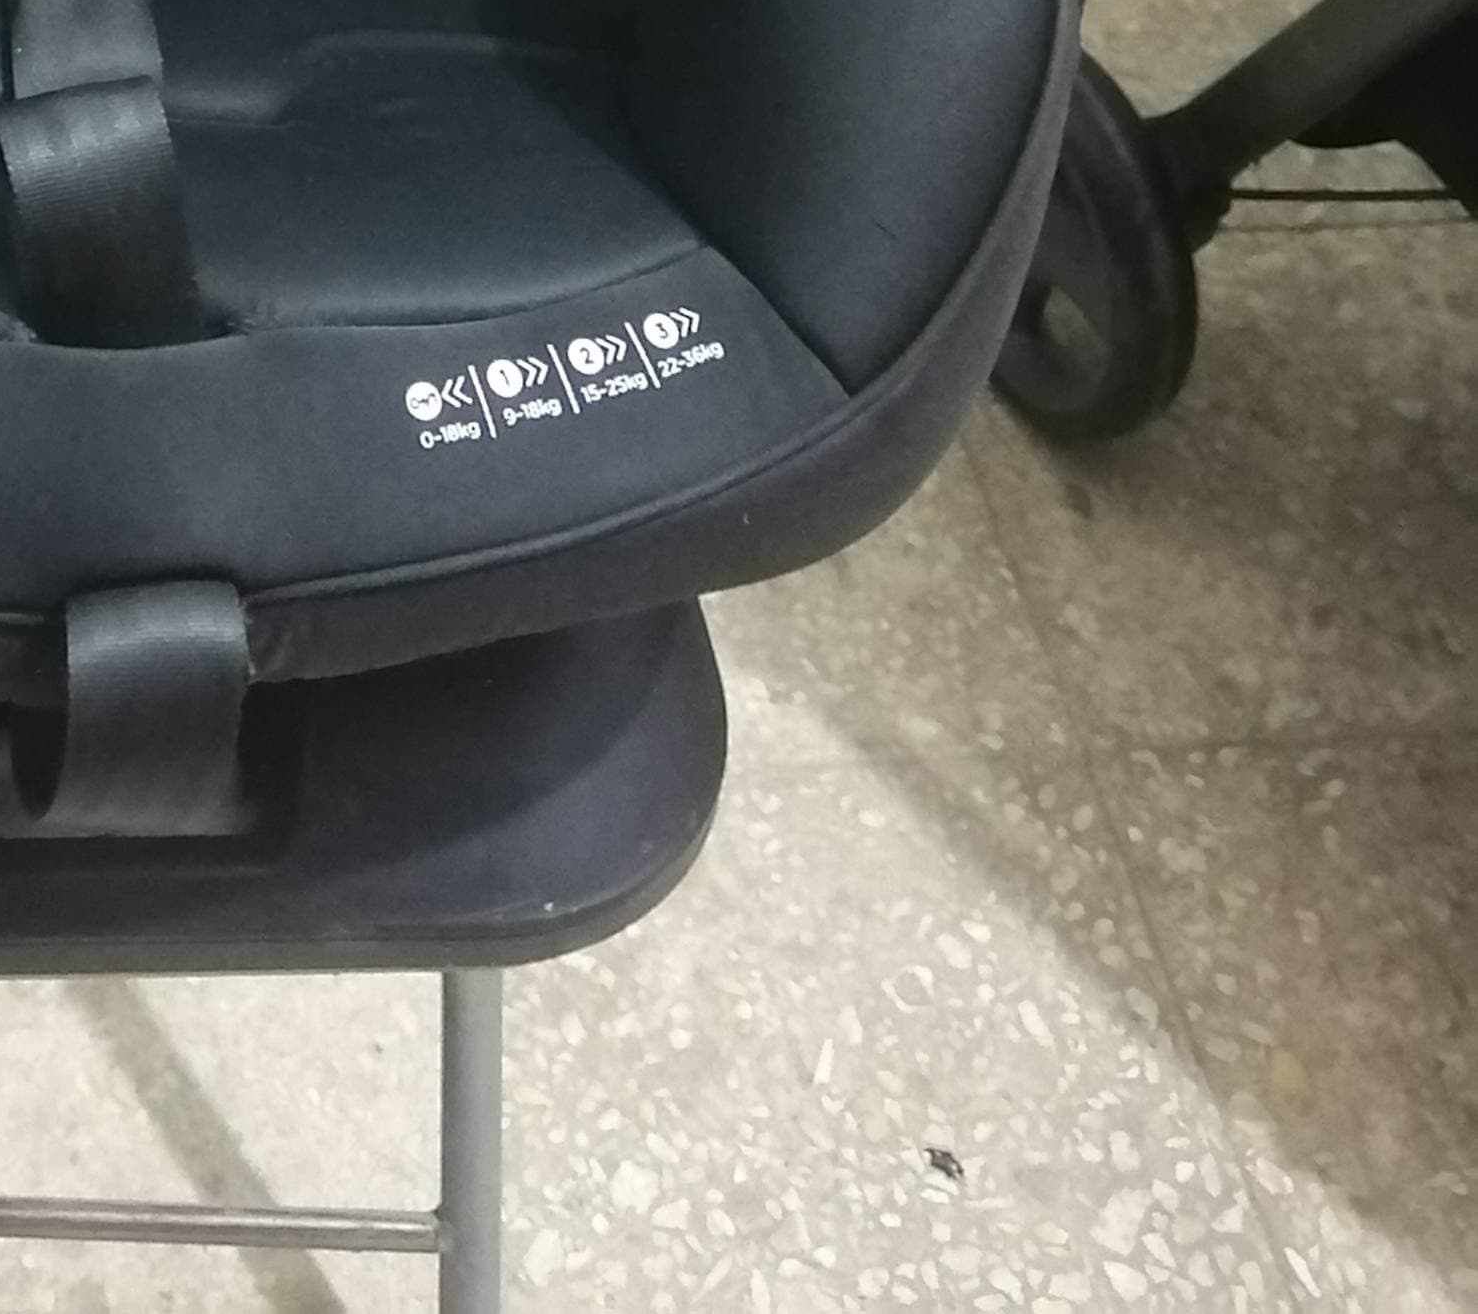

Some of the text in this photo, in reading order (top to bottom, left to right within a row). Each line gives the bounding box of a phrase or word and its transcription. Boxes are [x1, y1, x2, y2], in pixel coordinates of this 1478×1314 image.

[657, 342, 725, 378] 22-36kg
[580, 372, 649, 404] 15-25kg
[502, 398, 563, 426] 9-18kg
[419, 421, 482, 449] 0-18kg
